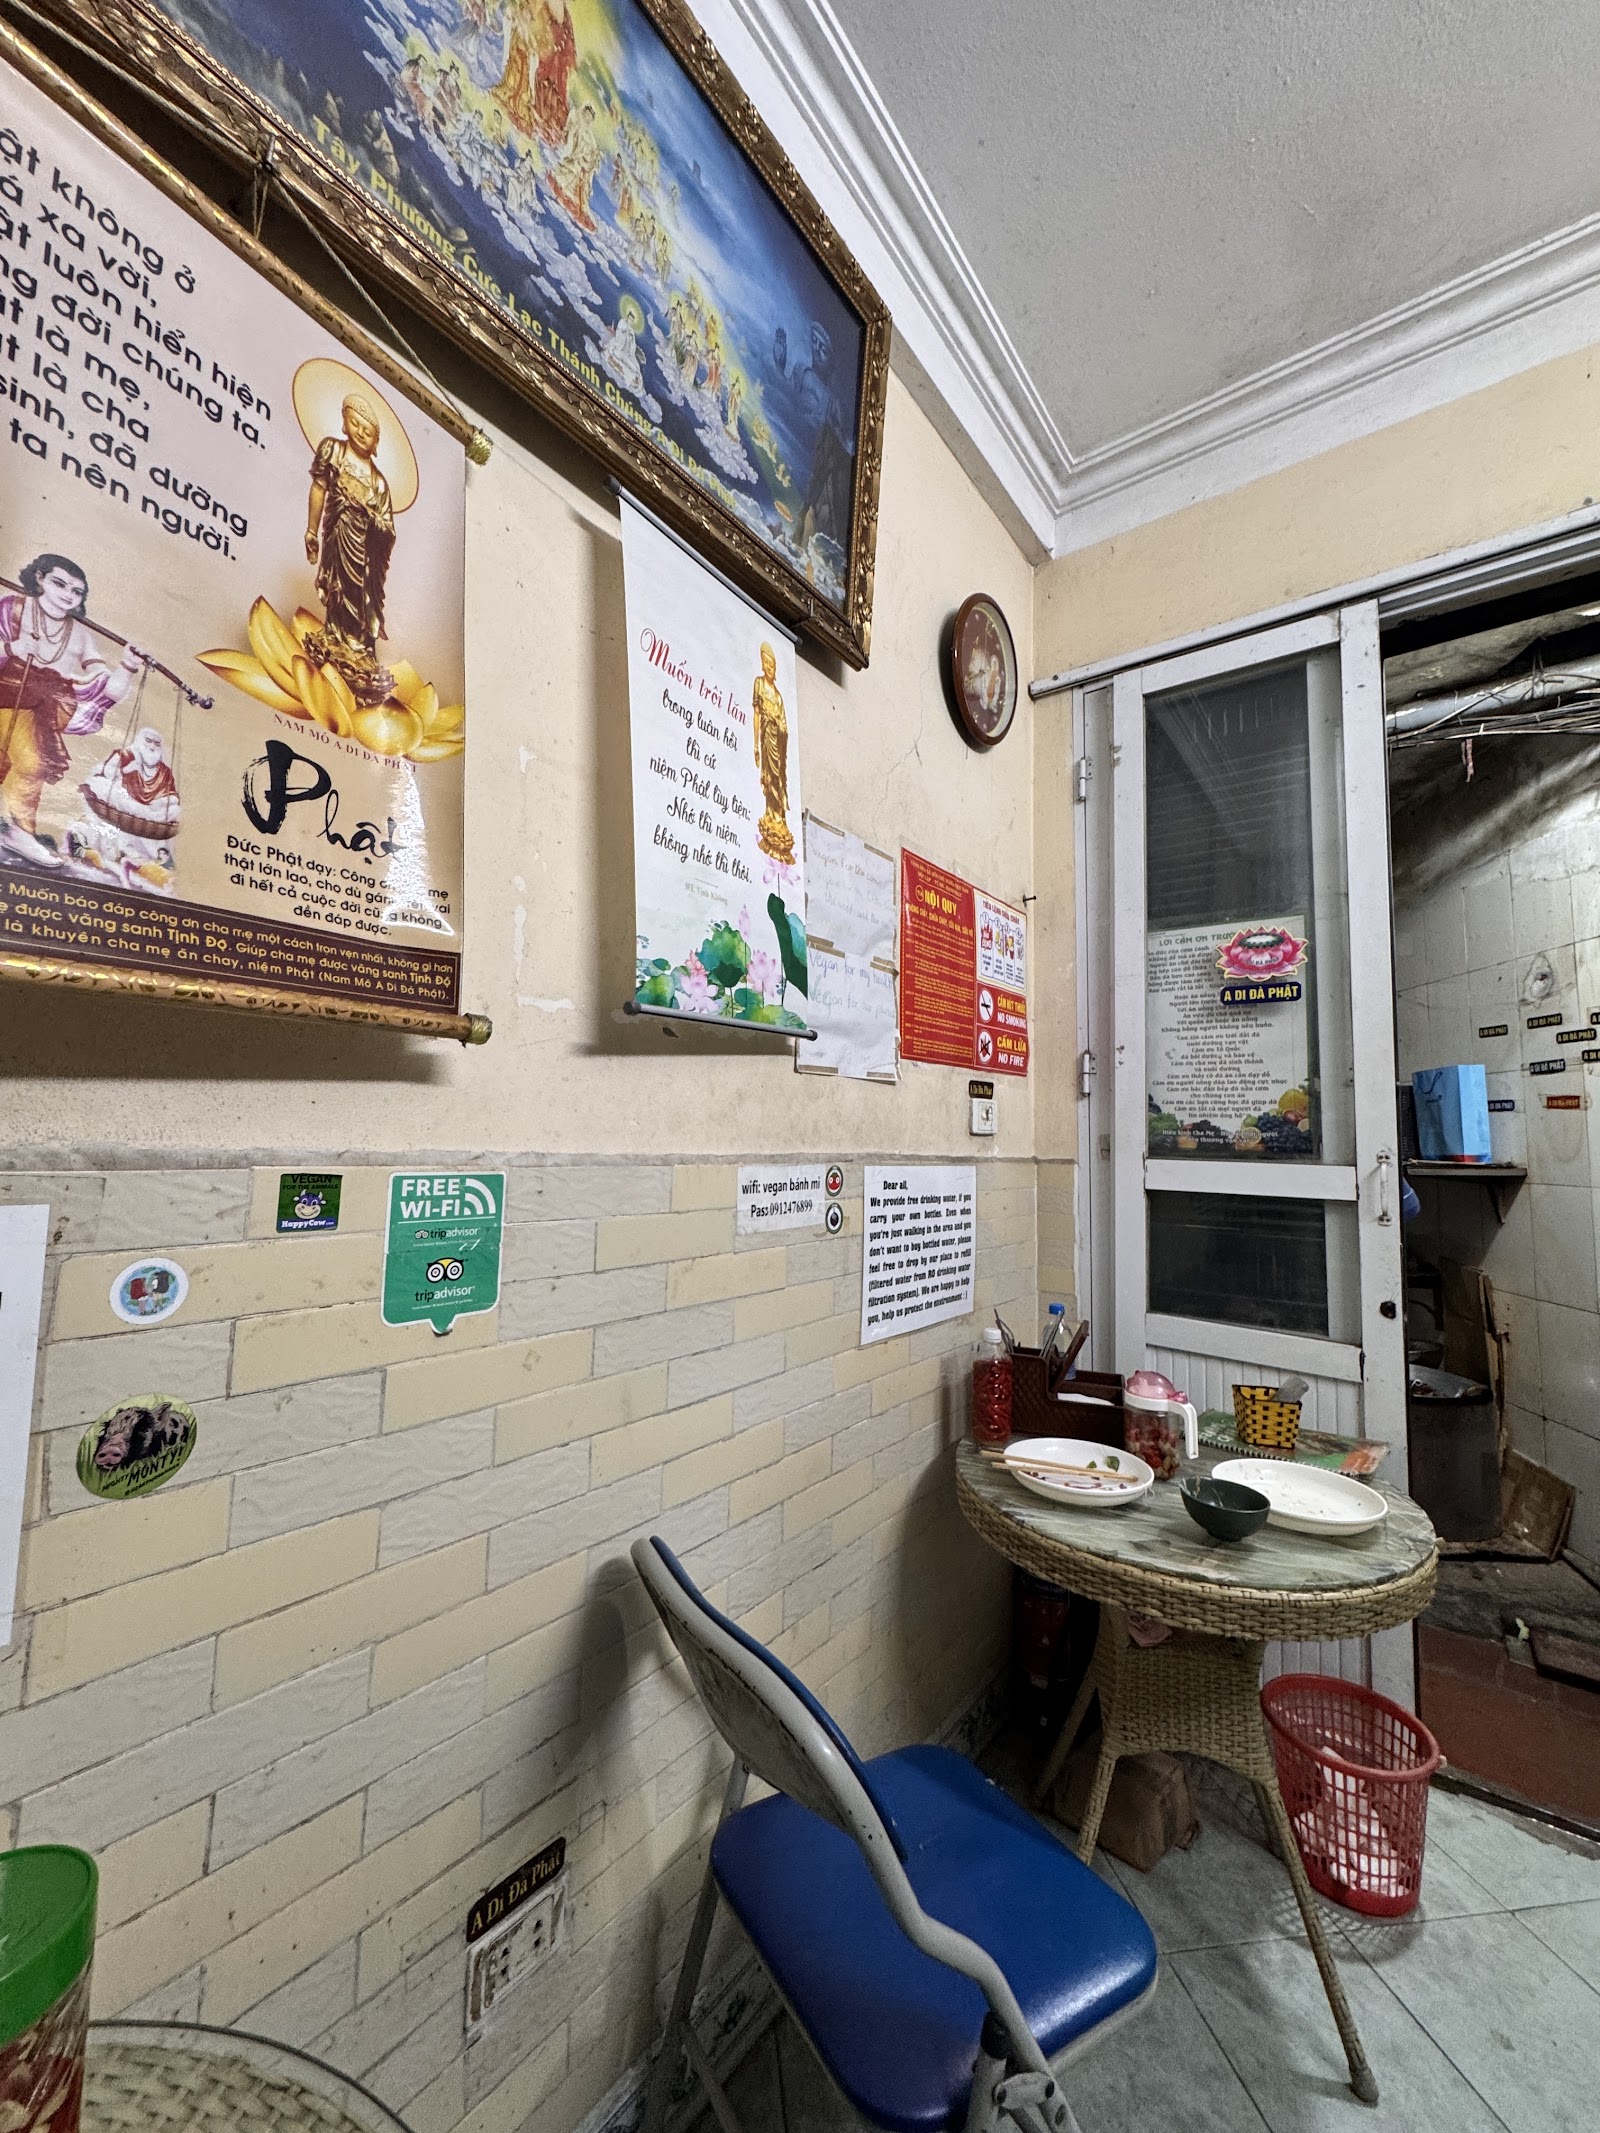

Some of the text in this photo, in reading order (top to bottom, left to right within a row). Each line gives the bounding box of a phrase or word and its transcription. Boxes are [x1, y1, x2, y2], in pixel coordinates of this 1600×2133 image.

[52, 166, 196, 294] không ở
[37, 203, 157, 308] xa vời,
[312, 113, 361, 176] Tây
[370, 170, 458, 263] Phương
[548, 327, 601, 389] Thánh
[43, 241, 271, 421] luôn hiển hiện
[35, 315, 150, 412] là mẹ,
[51, 294, 112, 346] đời
[122, 342, 223, 423] chúng
[32, 352, 149, 443] là cha
[9, 418, 237, 562] ta nên người.
[89, 431, 137, 471] đã
[149, 466, 248, 538] dưỡng
[640, 628, 747, 726] Muốn trôi lăn
[274, 713, 305, 734] NAM
[346, 744, 359, 756] DI
[662, 688, 738, 752] trong luân hồi
[686, 736, 717, 770] thì cứ
[649, 757, 678, 783] niệm
[680, 767, 711, 801] Phật
[241, 739, 405, 864] Phật
[666, 796, 696, 825] Nhớ
[698, 810, 713, 834] thì
[227, 834, 450, 901] Đức Phật dạy: Công mẹ
[653, 824, 752, 884] không nhớ thì thôi.
[224, 853, 256, 874] thật
[258, 862, 282, 878] lớn
[315, 876, 342, 893] cho
[345, 882, 362, 898] dù
[230, 873, 443, 929] đi hết cả cuộc đời không
[293, 905, 393, 936] đền đáp được.
[924, 889, 957, 916] NỘI QUY
[9, 882, 60, 903] Muốn
[64, 893, 99, 910] báo
[103, 901, 136, 918] đáp
[139, 909, 178, 928] công
[181, 918, 200, 929] ơn
[203, 921, 229, 935] cha
[232, 928, 254, 941] mẹ
[256, 932, 281, 945] một
[283, 937, 314, 951] cách
[316, 943, 337, 956] trọn
[340, 948, 359, 960] vẹn
[388, 956, 420, 972] không
[434, 963, 453, 974] hơn
[248, 960, 282, 975] niệm
[286, 965, 315, 981] Phật
[318, 971, 351, 986] (Nam
[354, 977, 372, 988] Mô
[375, 980, 384, 991] A
[386, 982, 397, 992] Di
[1224, 984, 1299, 1001] A DI ĐÀ PHẬT
[997, 1012, 1027, 1029] NO SMOKING
[996, 1034, 1013, 1050] CẤM
[998, 1052, 1025, 1067] NO FIRE
[291, 1175, 333, 1184] VEGAN
[401, 1178, 461, 1197] FREE
[742, 1180, 761, 1194] wifi:
[763, 1181, 788, 1196] vegan
[789, 1177, 809, 1191] bánh
[883, 1180, 908, 1191] Dear all,
[400, 1199, 461, 1219] WI-FI
[869, 1207, 972, 1224] carry your own bottles. Even when
[870, 1197, 881, 1207] We
[882, 1196, 906, 1208] provide
[907, 1195, 919, 1206] free
[920, 1194, 941, 1205] drinking
[963, 1194, 972, 1203] you
[430, 1227, 479, 1241] tripadvisor
[415, 1286, 474, 1303] tripadvisor
[127, 1446, 184, 1487] MONTY!
[471, 1911, 483, 1935] A
